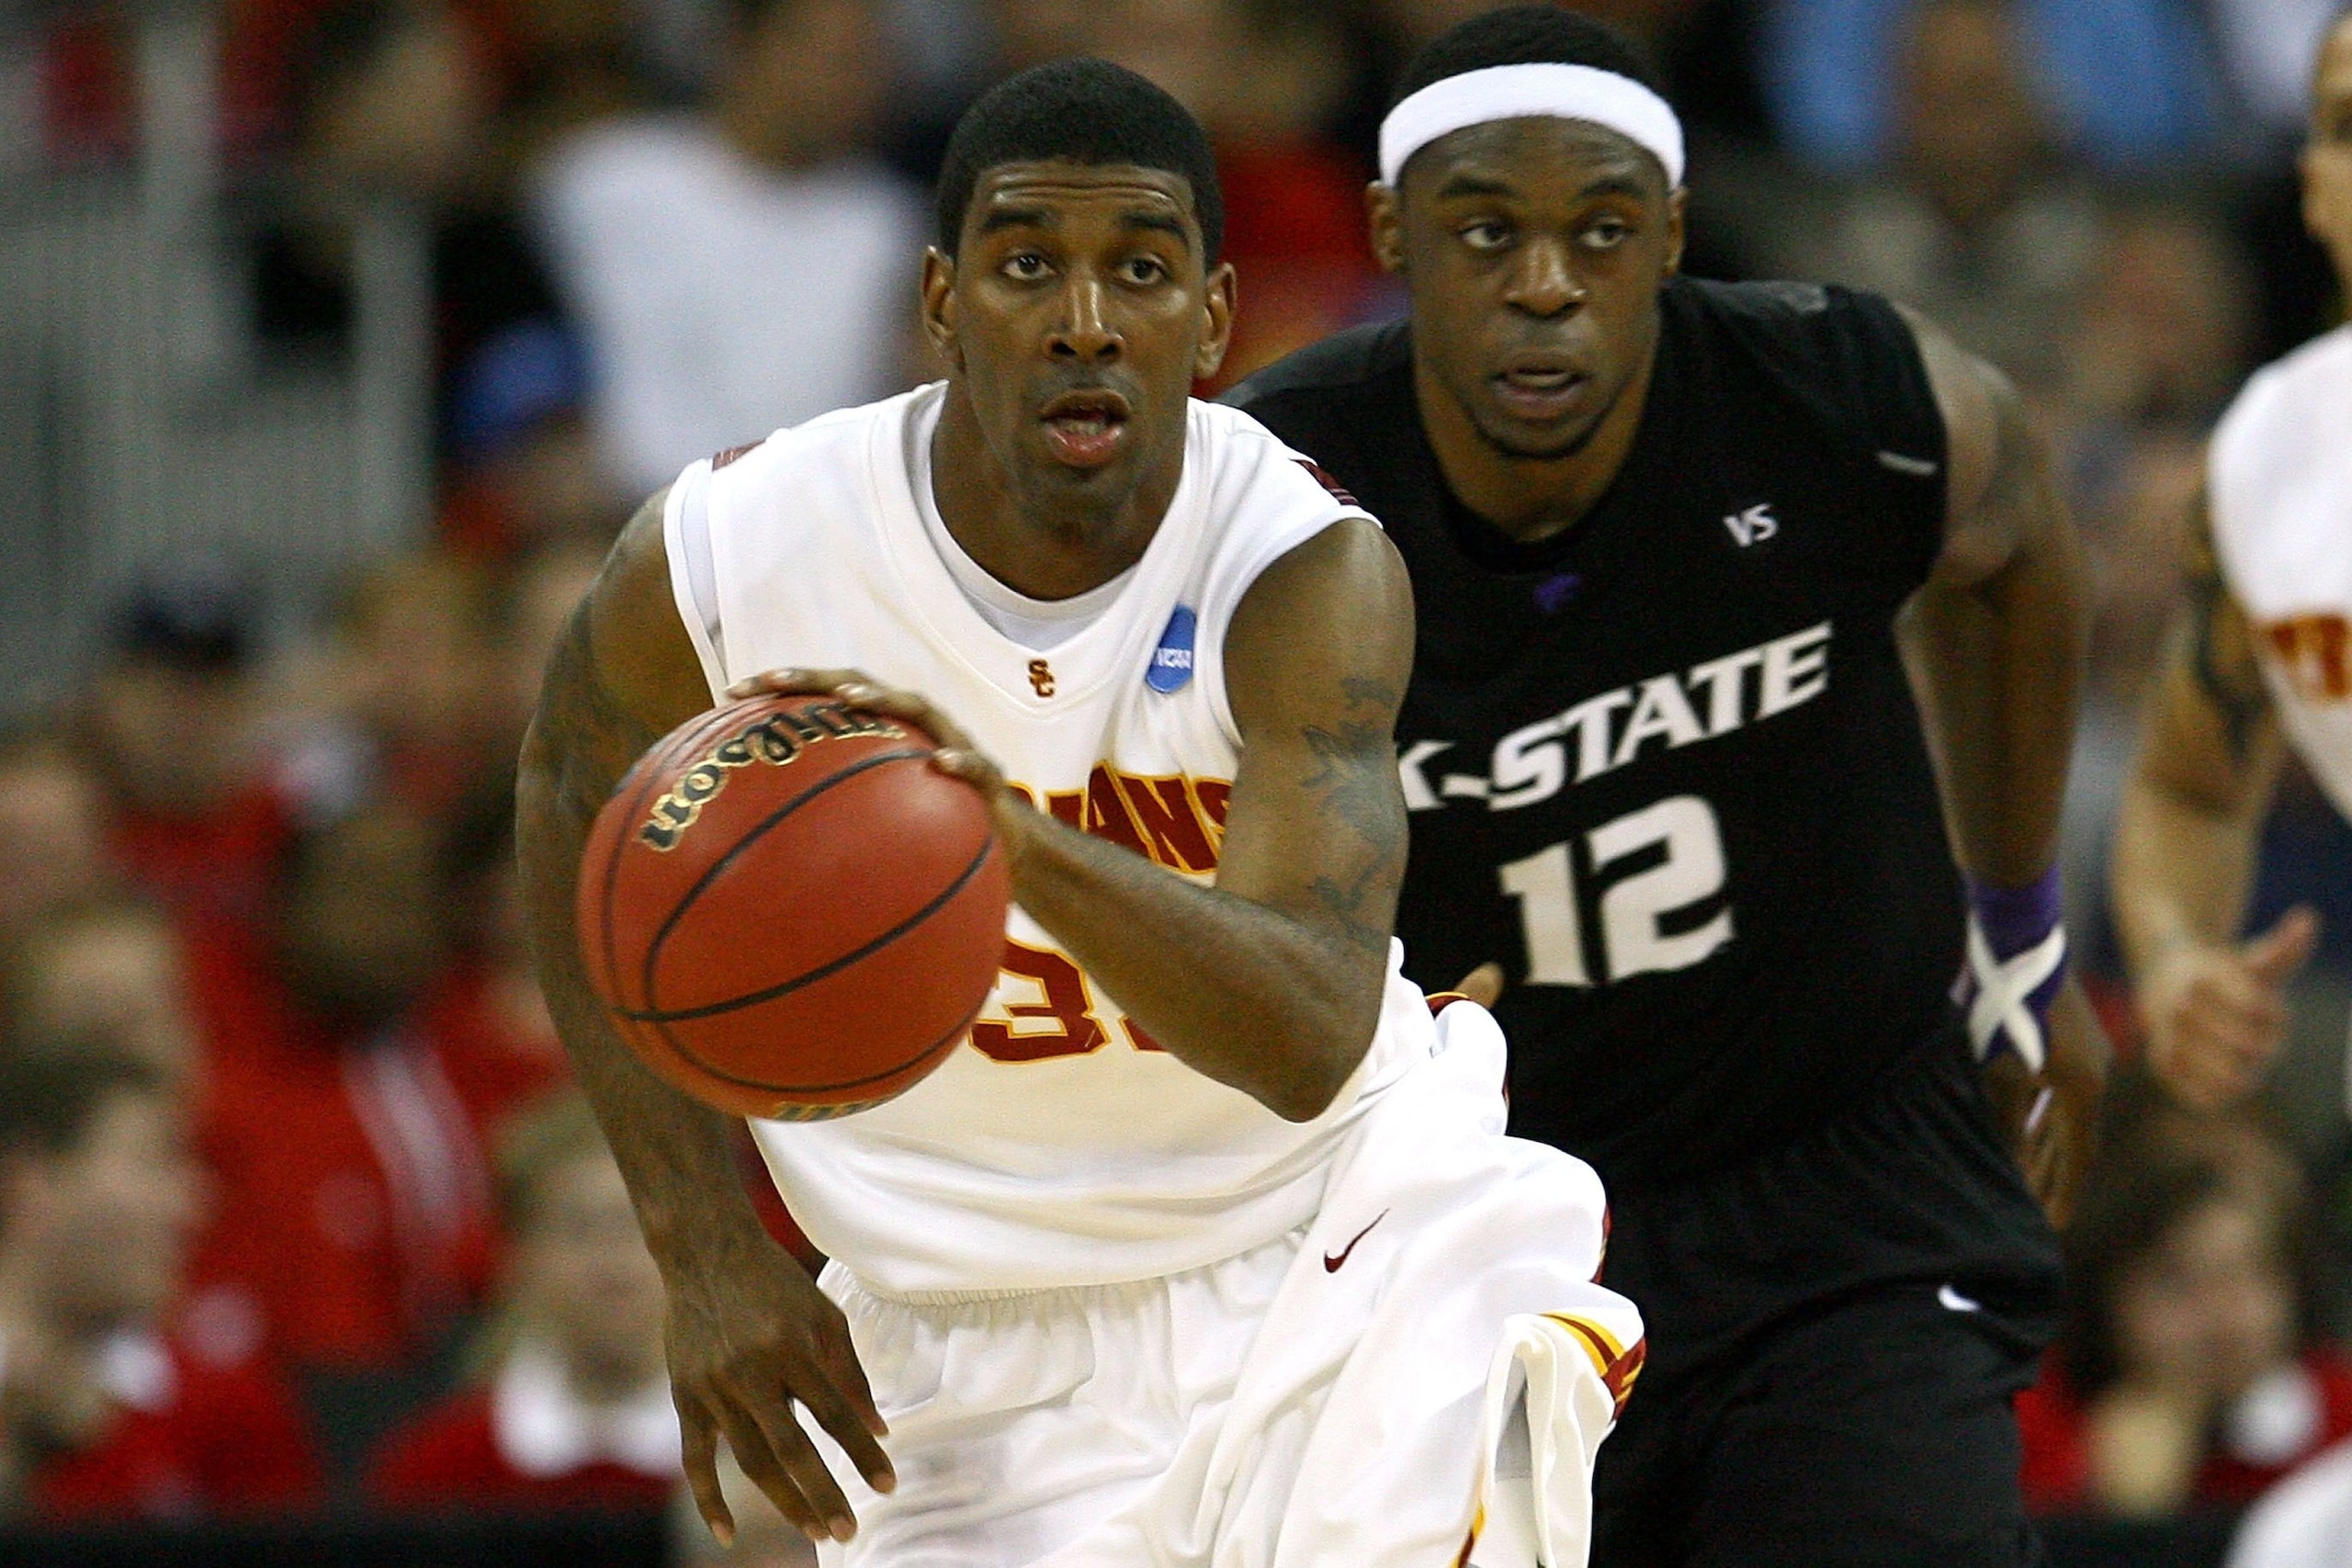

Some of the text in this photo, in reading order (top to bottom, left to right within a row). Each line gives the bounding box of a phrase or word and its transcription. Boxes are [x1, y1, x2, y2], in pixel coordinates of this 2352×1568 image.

[1724, 503, 1780, 547] VS
[1396, 619, 1833, 812] K-STATE
[1498, 795, 1738, 989] 12
